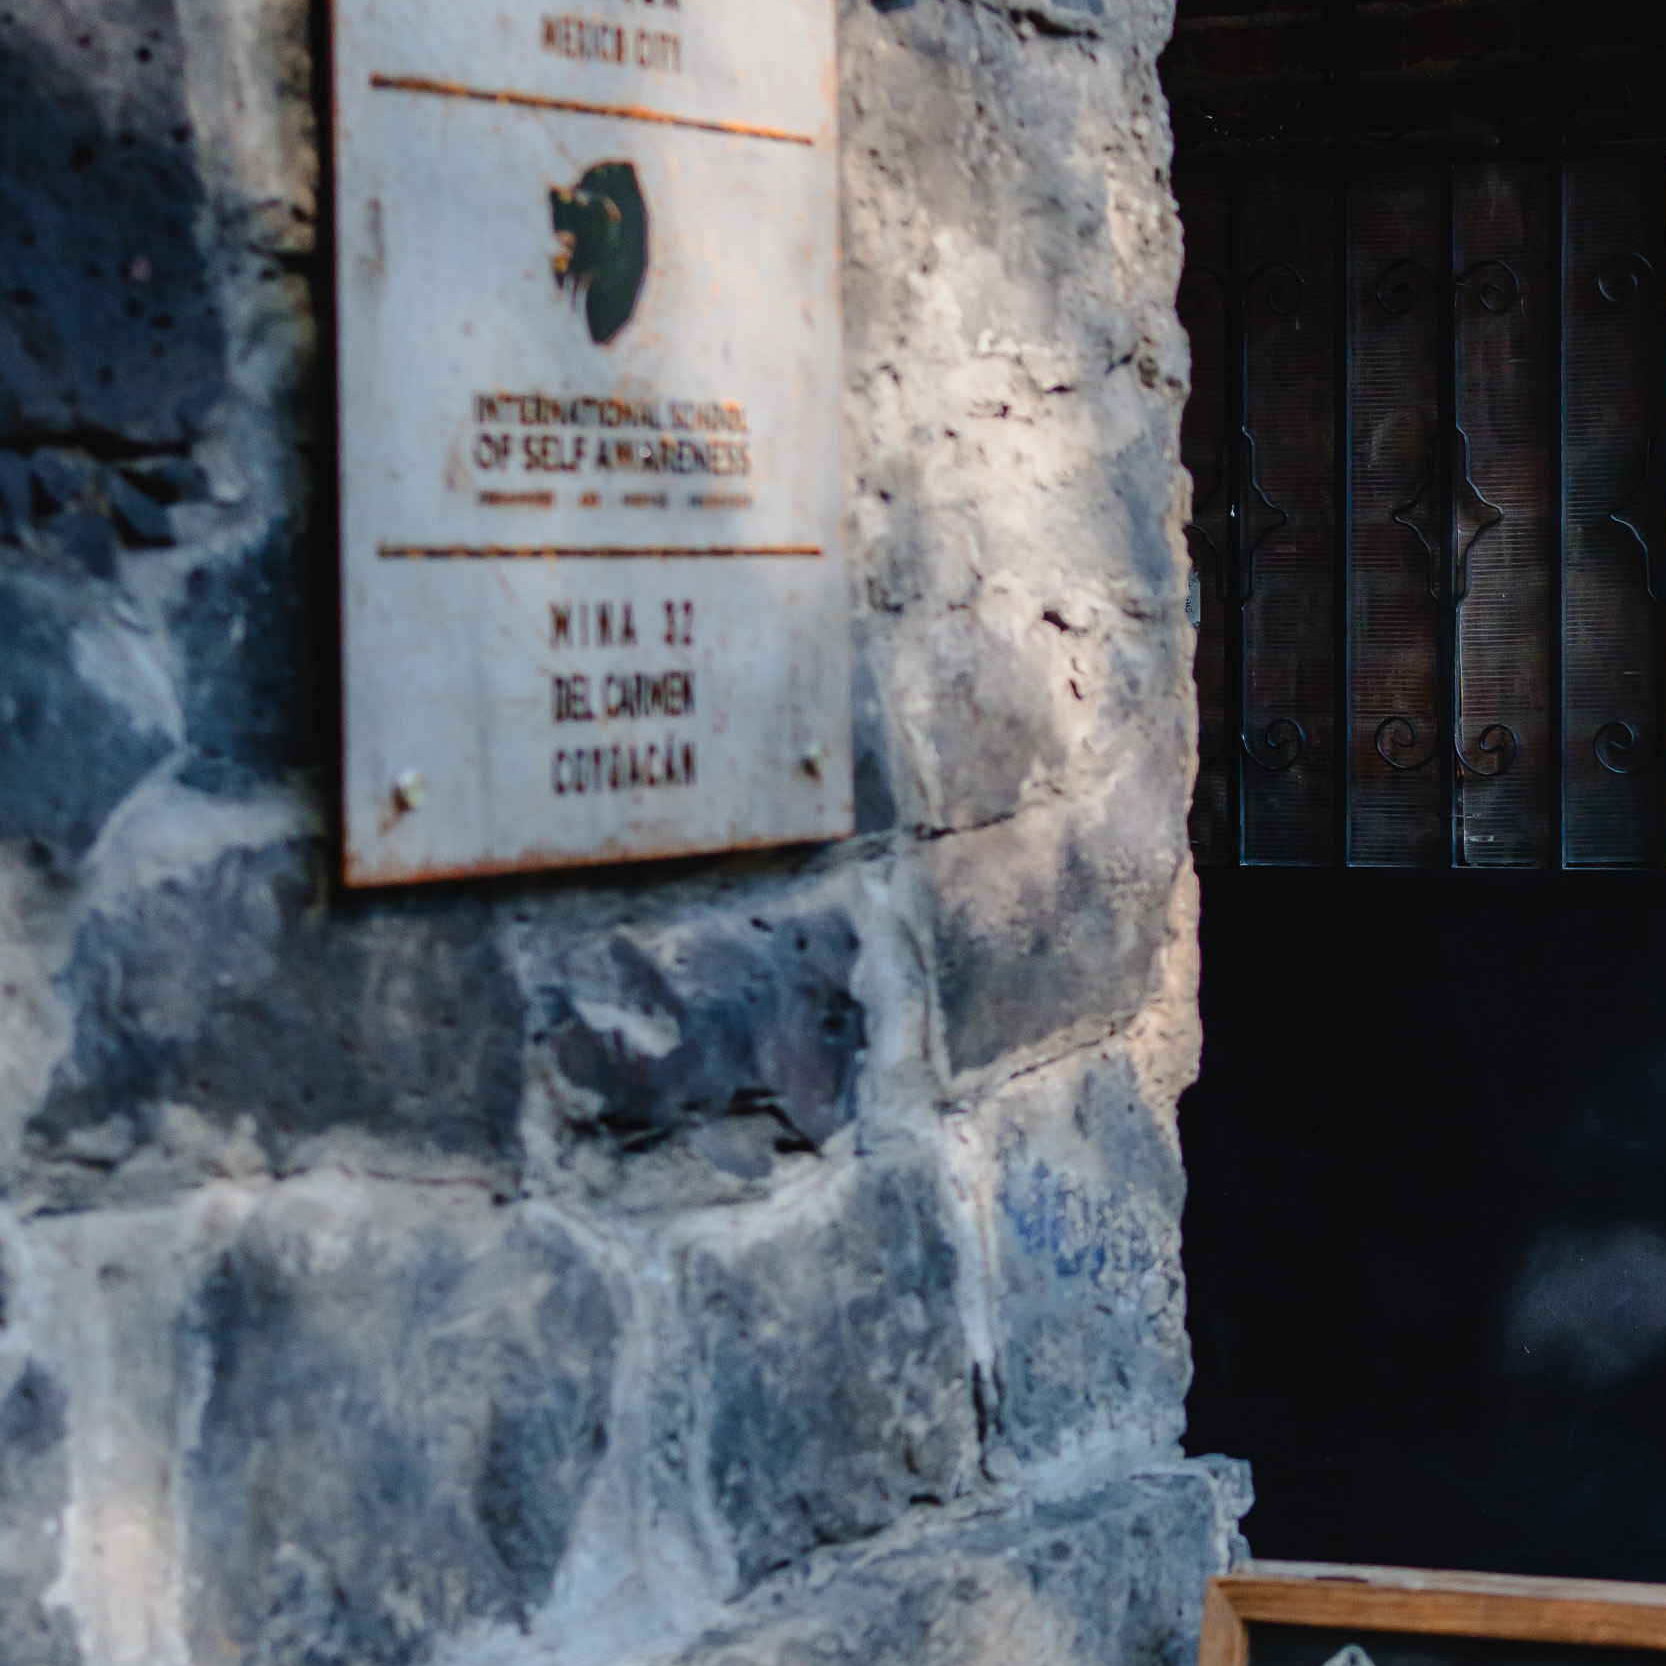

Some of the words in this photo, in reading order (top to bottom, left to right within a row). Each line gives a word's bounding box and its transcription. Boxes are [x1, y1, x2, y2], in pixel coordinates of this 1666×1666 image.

[474, 433, 511, 471] OF
[523, 434, 586, 471] SELF
[553, 673, 595, 721] DEL
